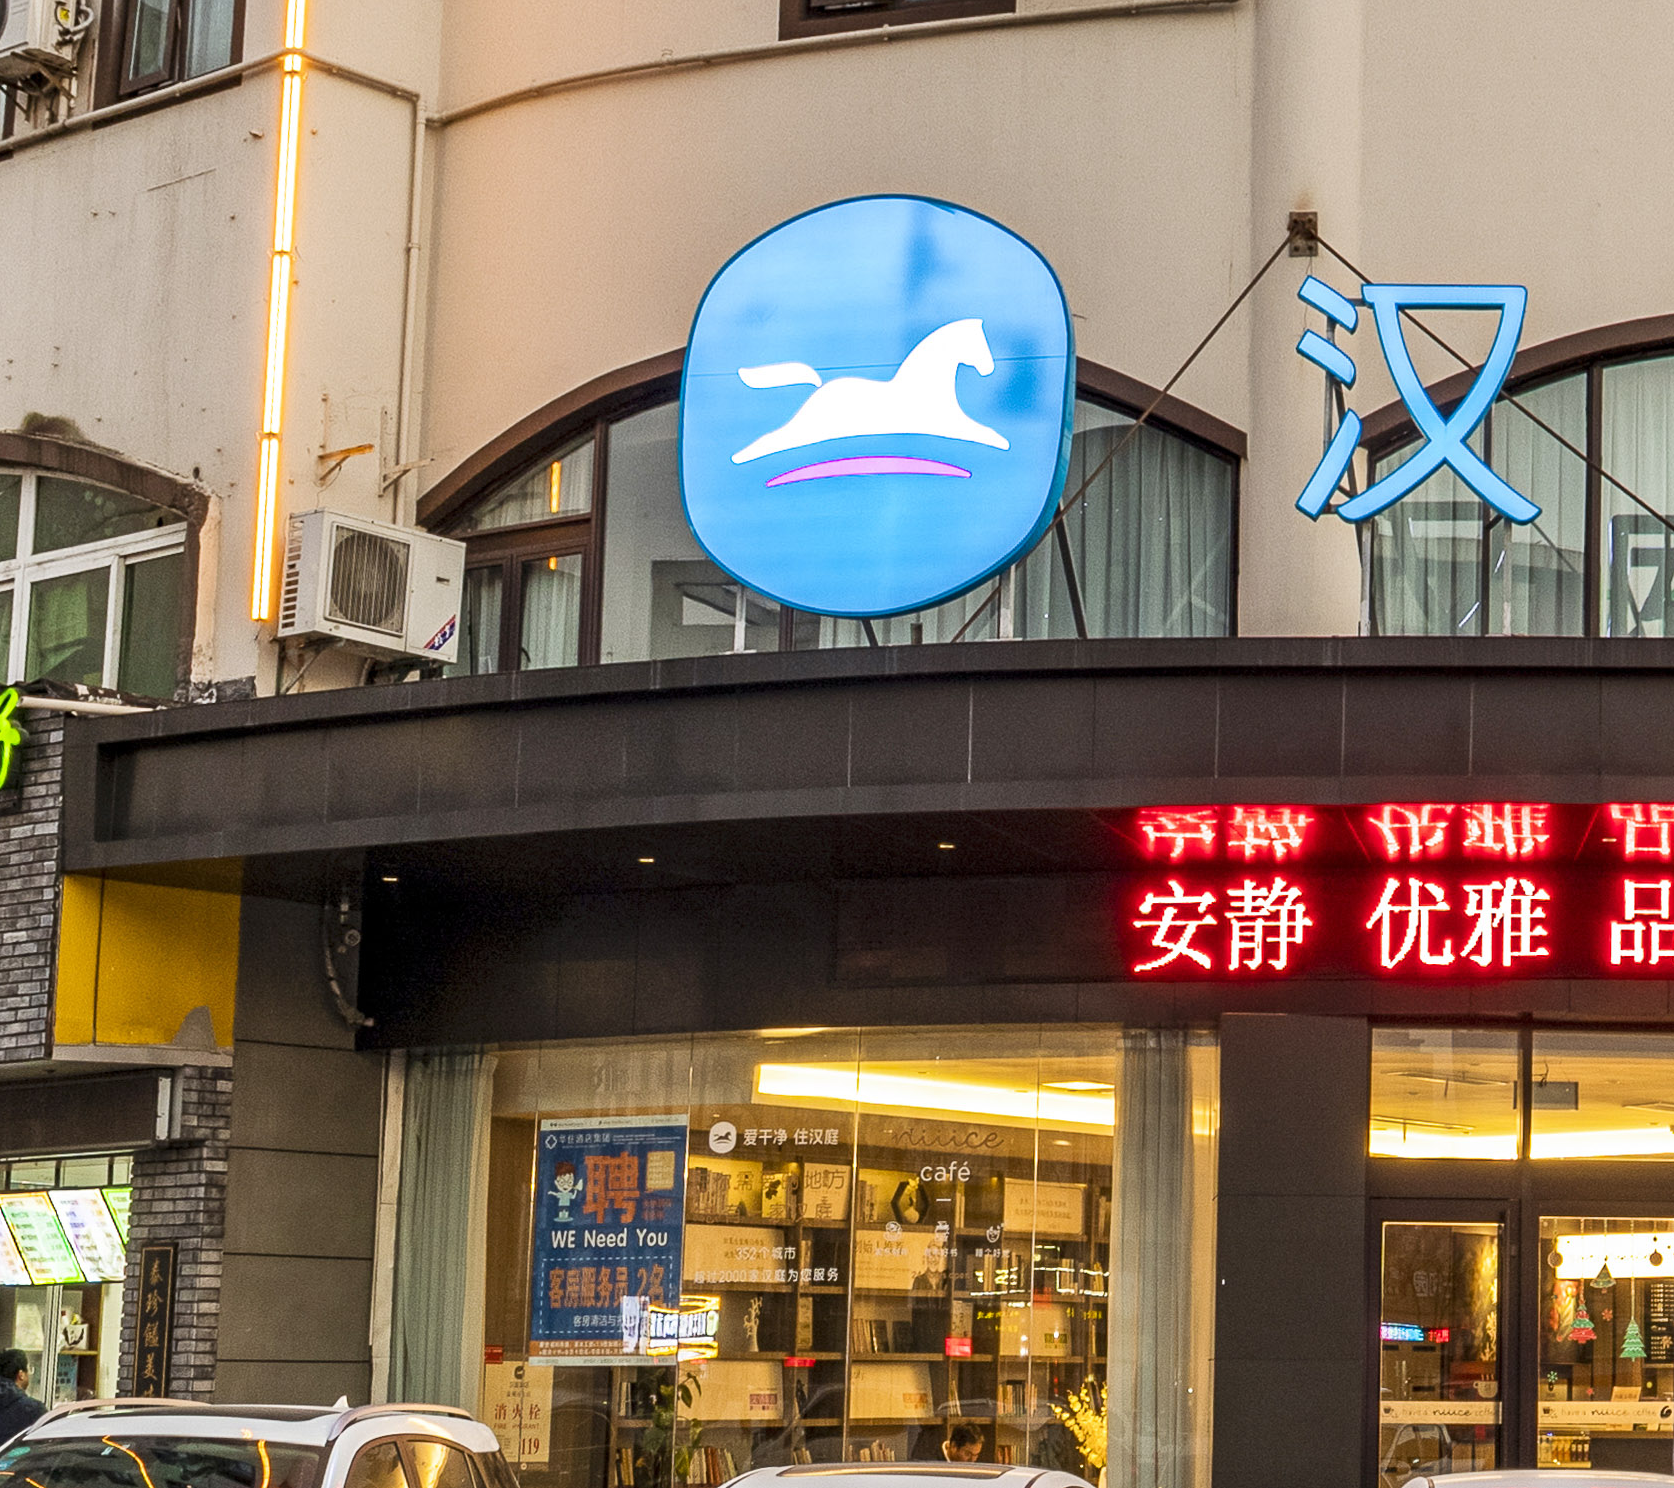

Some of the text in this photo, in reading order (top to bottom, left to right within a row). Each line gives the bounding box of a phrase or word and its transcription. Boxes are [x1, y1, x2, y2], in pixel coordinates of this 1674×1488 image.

[1133, 875, 1313, 974] 安静
[1365, 876, 1552, 973] 优雅
[742, 1128, 839, 1146] 爱干净 住汉庭
[920, 1160, 971, 1183] café
[583, 1151, 640, 1224] 聘
[551, 1227, 668, 1249] WE Need You
[549, 1265, 629, 1309] 客房服务员
[494, 1403, 541, 1421] 消火栓
[521, 1437, 540, 1456] 119
